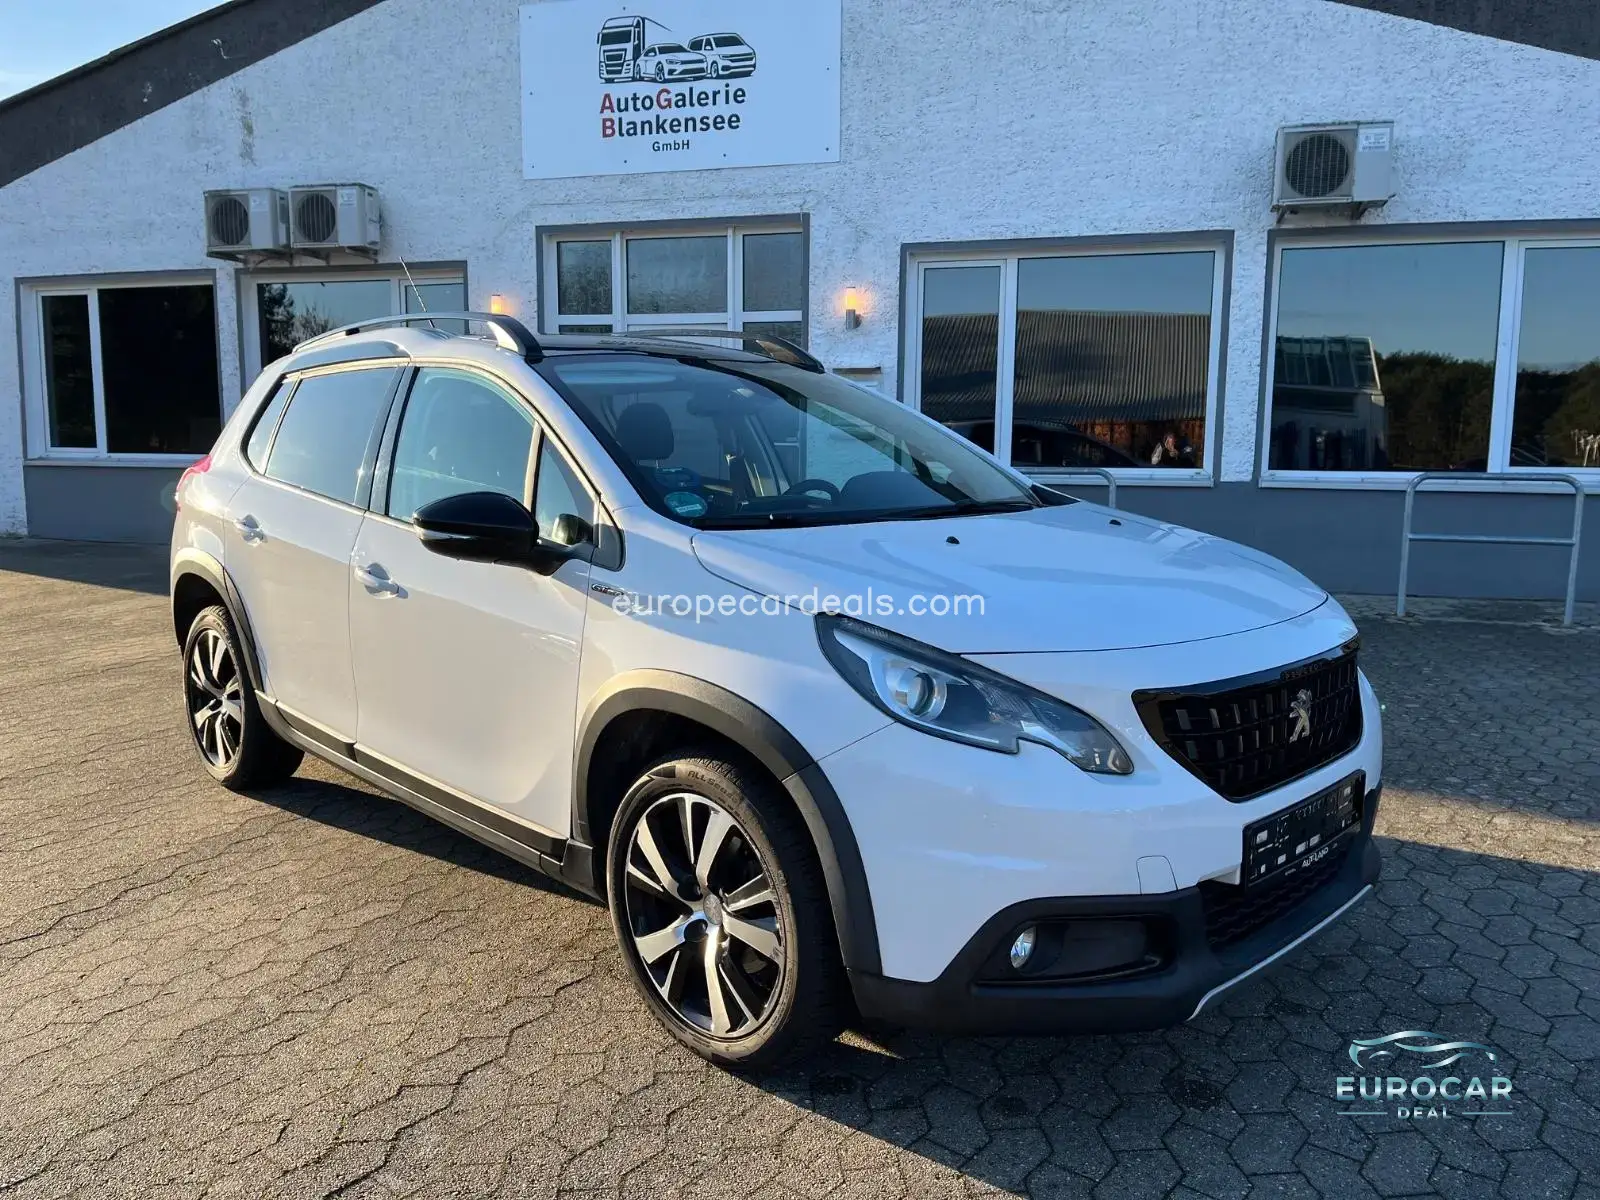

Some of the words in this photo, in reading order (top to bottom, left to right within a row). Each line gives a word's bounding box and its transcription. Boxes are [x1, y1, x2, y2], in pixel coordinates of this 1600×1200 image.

[599, 83, 747, 114] AutoGalerie
[601, 112, 741, 139] Blankensee
[652, 139, 690, 152] GmbH
